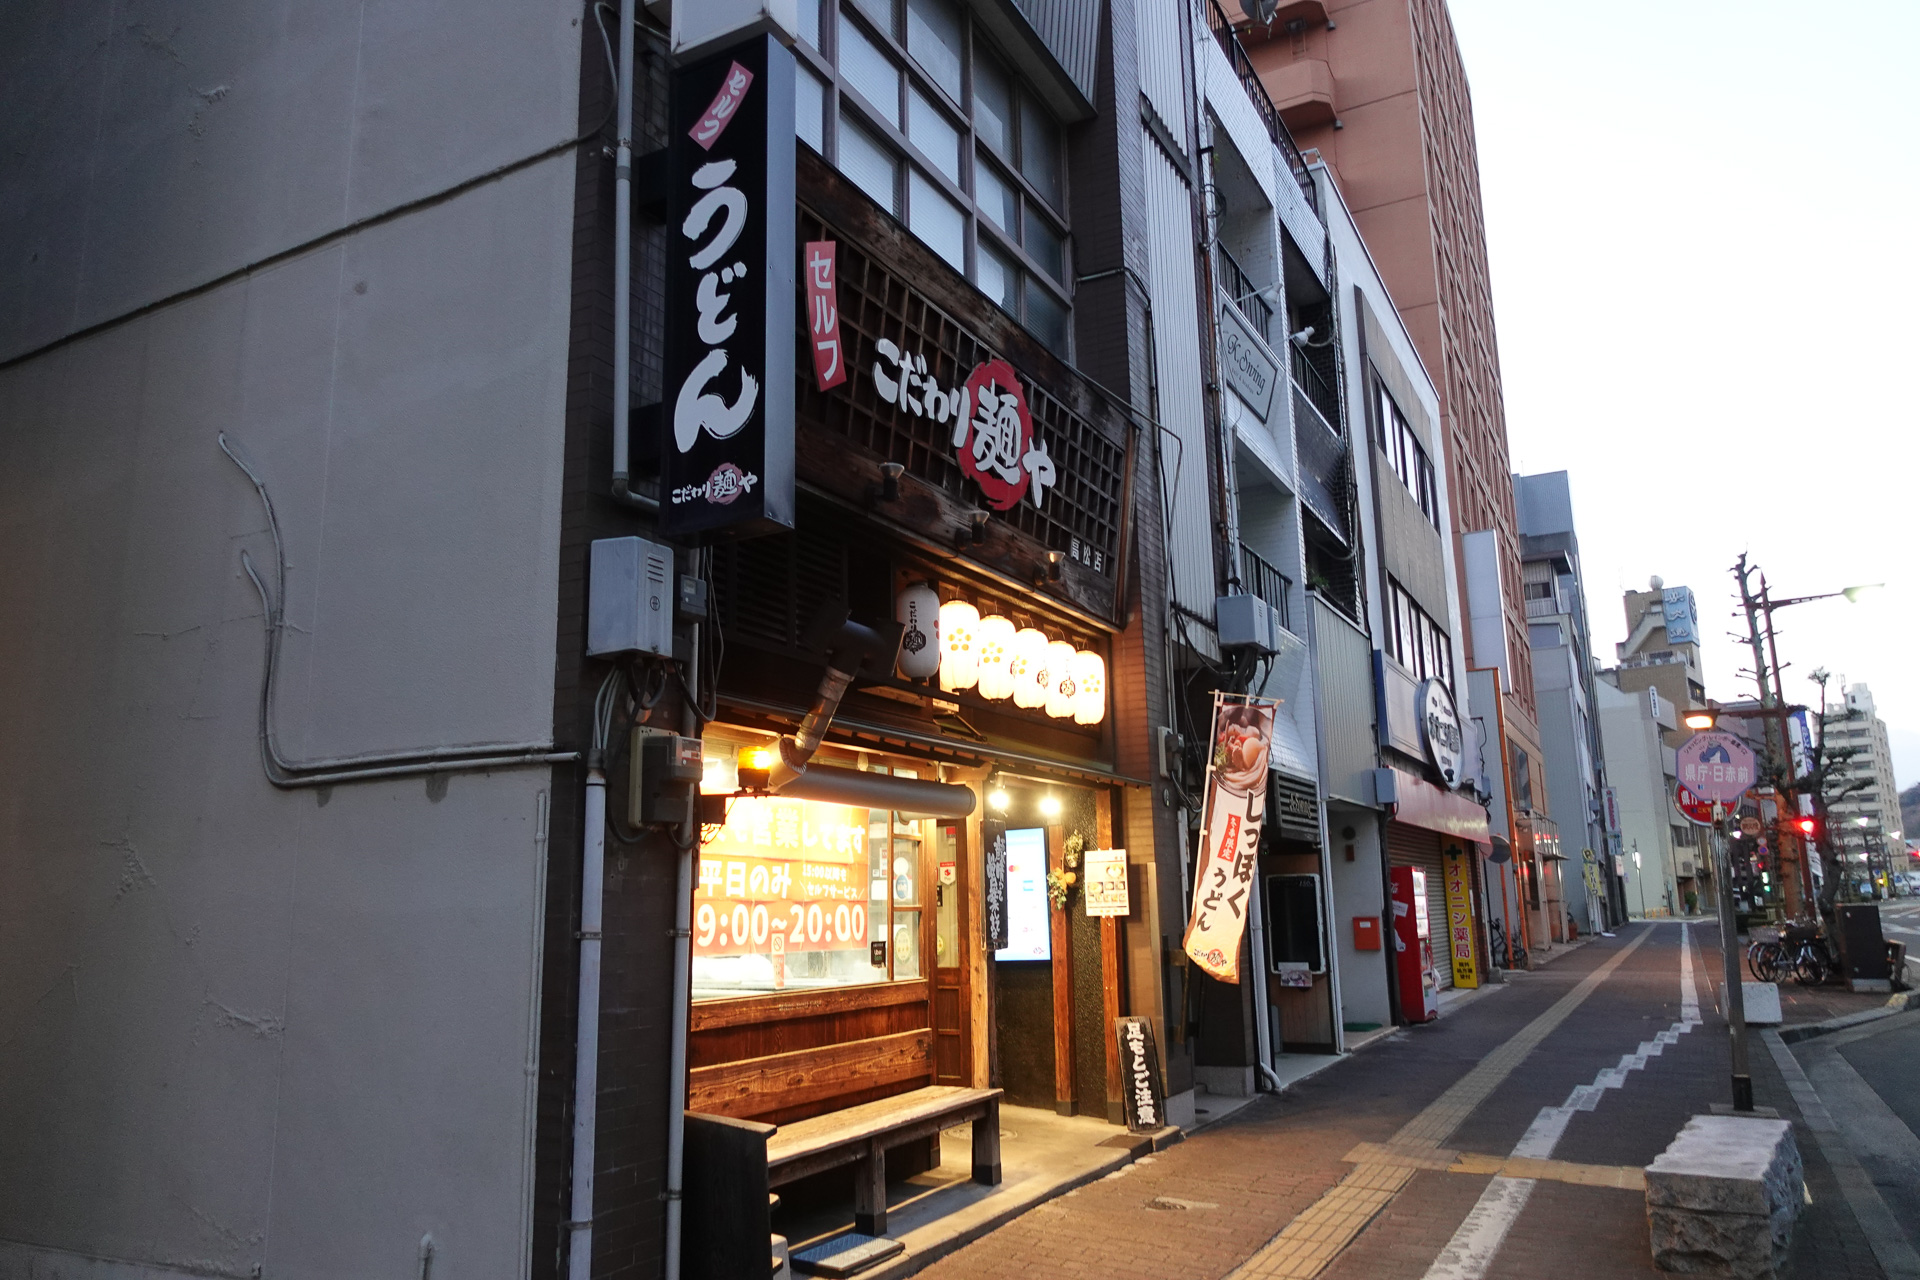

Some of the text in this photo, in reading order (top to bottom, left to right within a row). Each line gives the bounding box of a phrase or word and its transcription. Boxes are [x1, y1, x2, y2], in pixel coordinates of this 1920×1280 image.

[697, 69, 746, 141] セルフ
[673, 158, 759, 453] うどん
[810, 251, 838, 382] セルフ
[872, 338, 1057, 509] こだわり麺や
[671, 468, 758, 504] こだわり麺や
[1072, 537, 1102, 573] 高松店
[1685, 763, 1749, 784] 県庁・日赤前
[699, 859, 792, 899] 平日のみ
[806, 880, 858, 900] セルフサービス
[1197, 867, 1226, 932] うどん
[1448, 863, 1470, 959] オオニシ薬局
